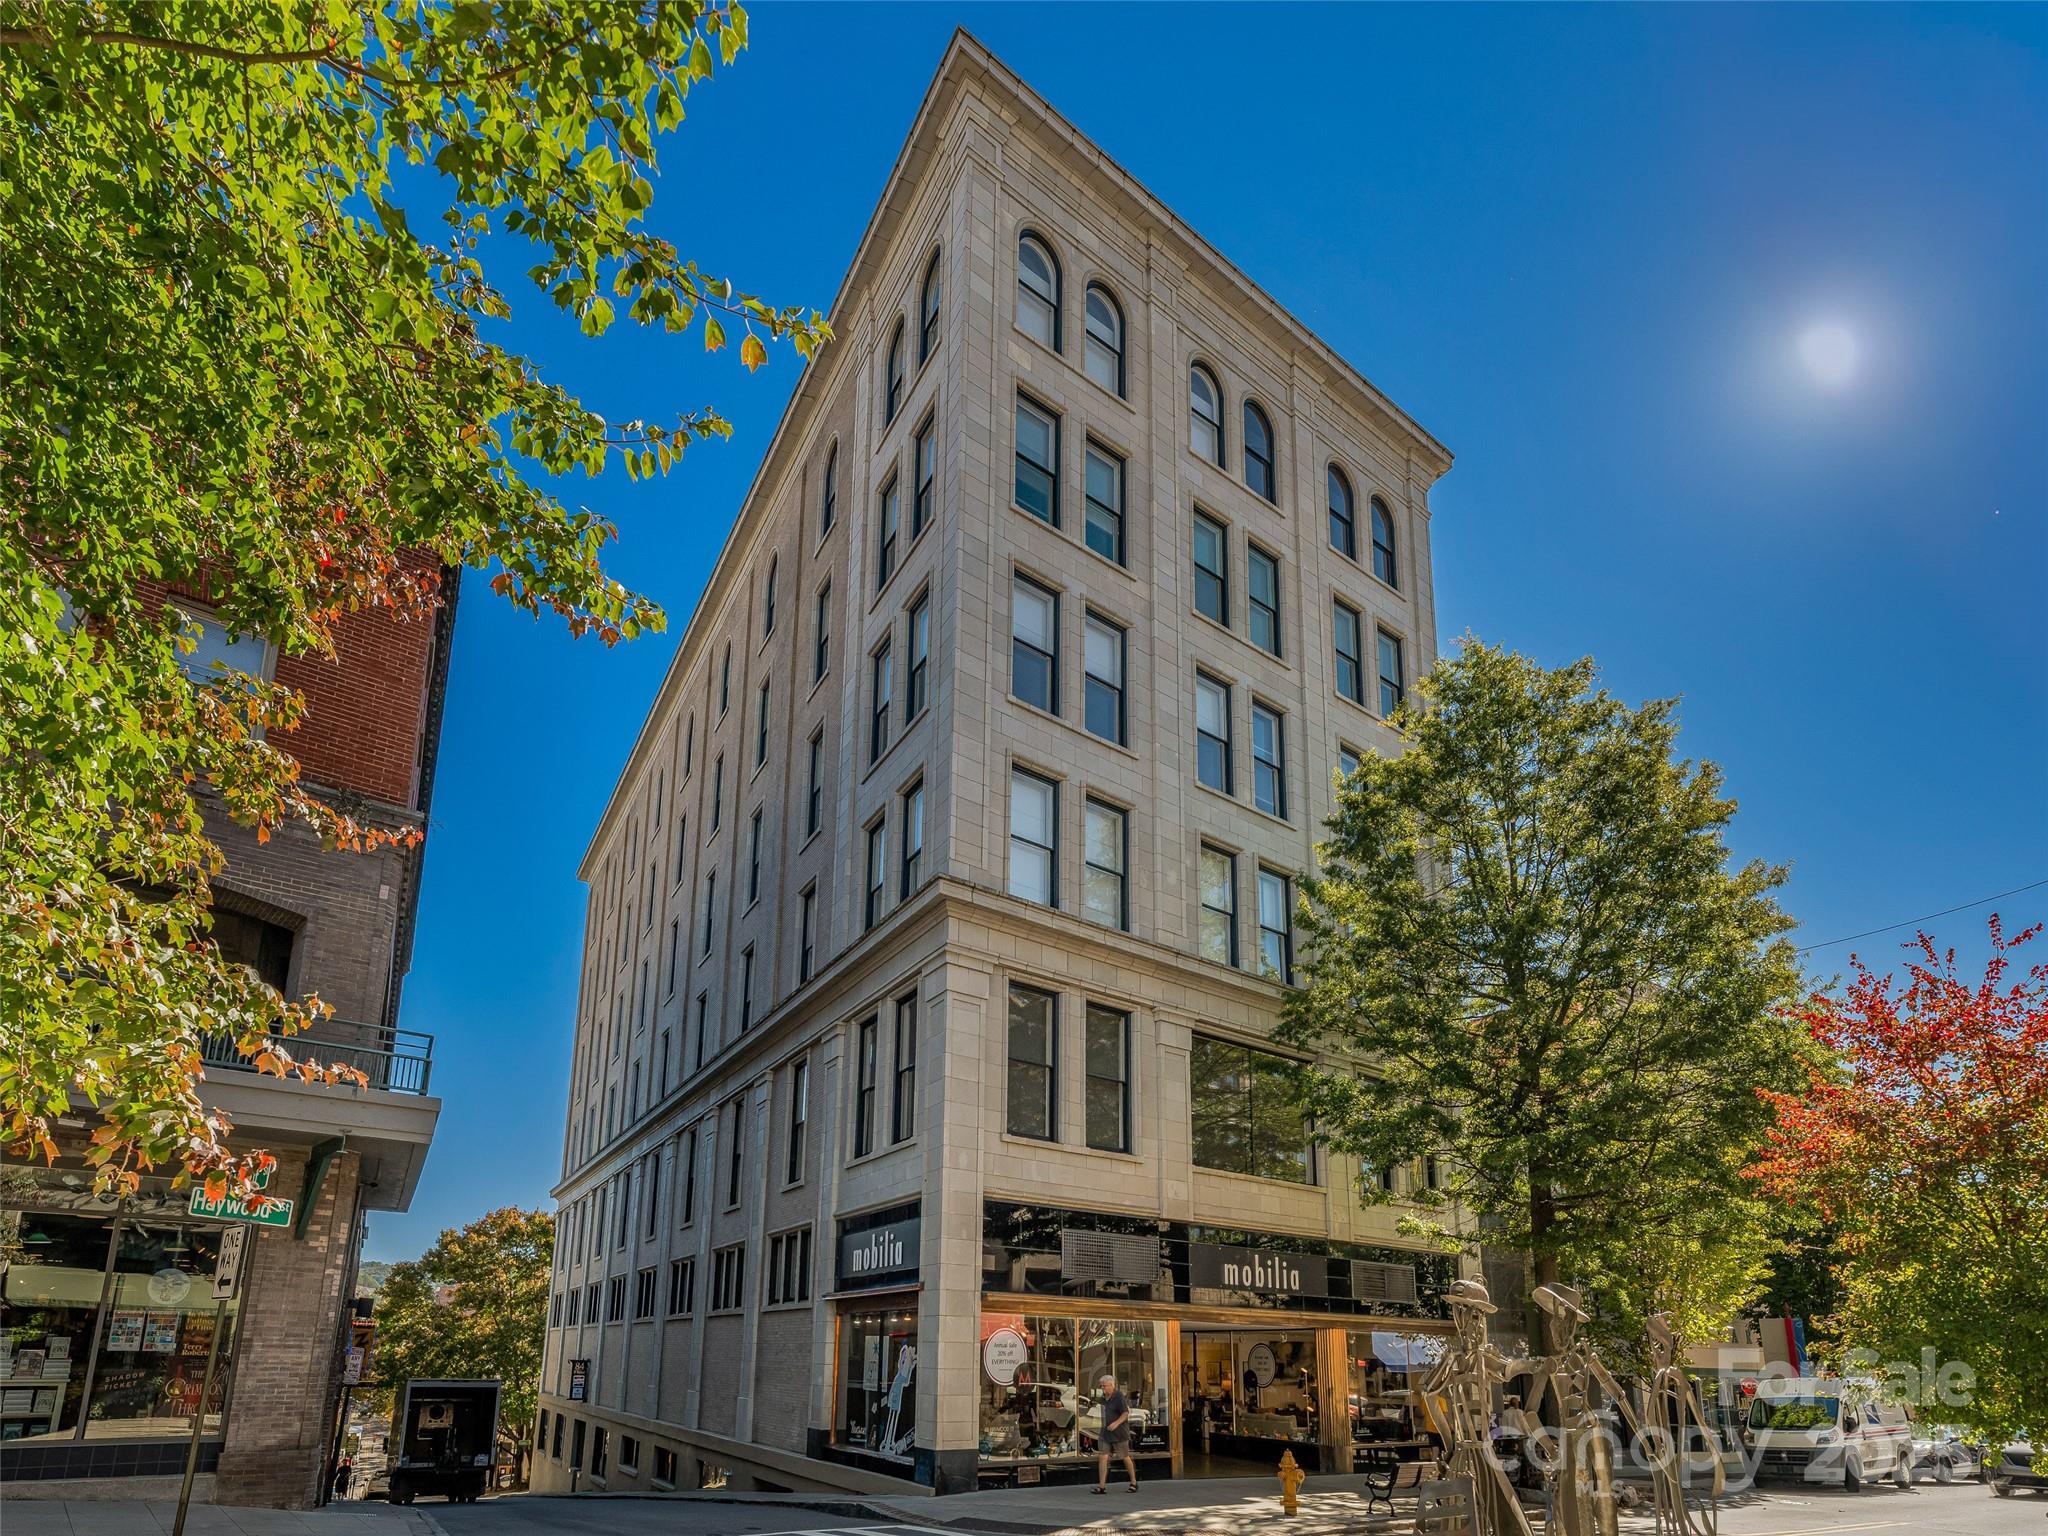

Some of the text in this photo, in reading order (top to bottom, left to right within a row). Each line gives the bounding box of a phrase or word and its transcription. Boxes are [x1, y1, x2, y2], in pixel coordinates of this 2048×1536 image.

[223, 1232, 241, 1249] ONE
[853, 1231, 903, 1272] mobilia
[220, 1252, 238, 1269] WAY
[1224, 1254, 1299, 1291] mobilia
[104, 1371, 145, 1382] SHADOW
[104, 1380, 137, 1391] TICKET
